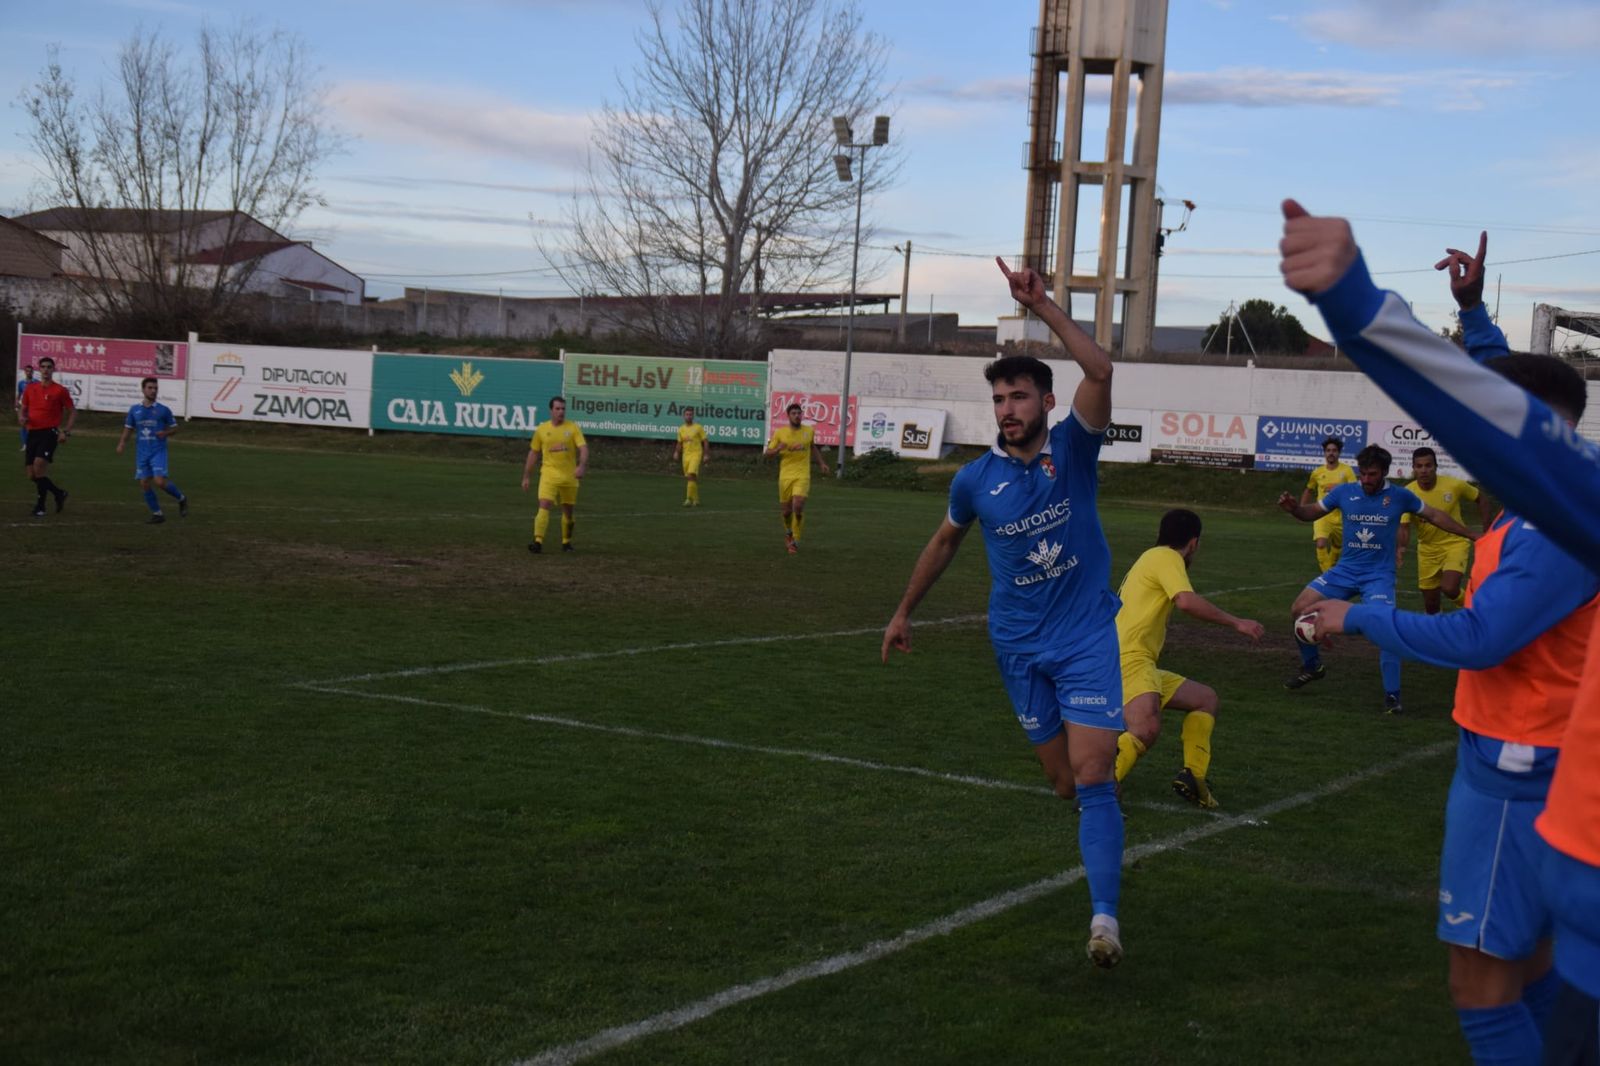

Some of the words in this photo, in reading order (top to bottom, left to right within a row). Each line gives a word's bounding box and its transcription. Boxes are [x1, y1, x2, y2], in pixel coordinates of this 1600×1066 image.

[32, 340, 66, 353] HOTEL
[253, 394, 352, 422] ZAMORA
[387, 398, 448, 426] CAJA
[454, 402, 542, 431] RURAL
[654, 403, 663, 418] y
[667, 401, 765, 420] Aruitectura
[718, 426, 738, 438] 524
[741, 427, 760, 439] 133
[1160, 412, 1248, 439] SOLA
[1280, 421, 1363, 437] LUMINOSOS
[903, 429, 929, 446] Susi
[1004, 498, 1070, 536] euronics
[1350, 513, 1389, 522] euronics
